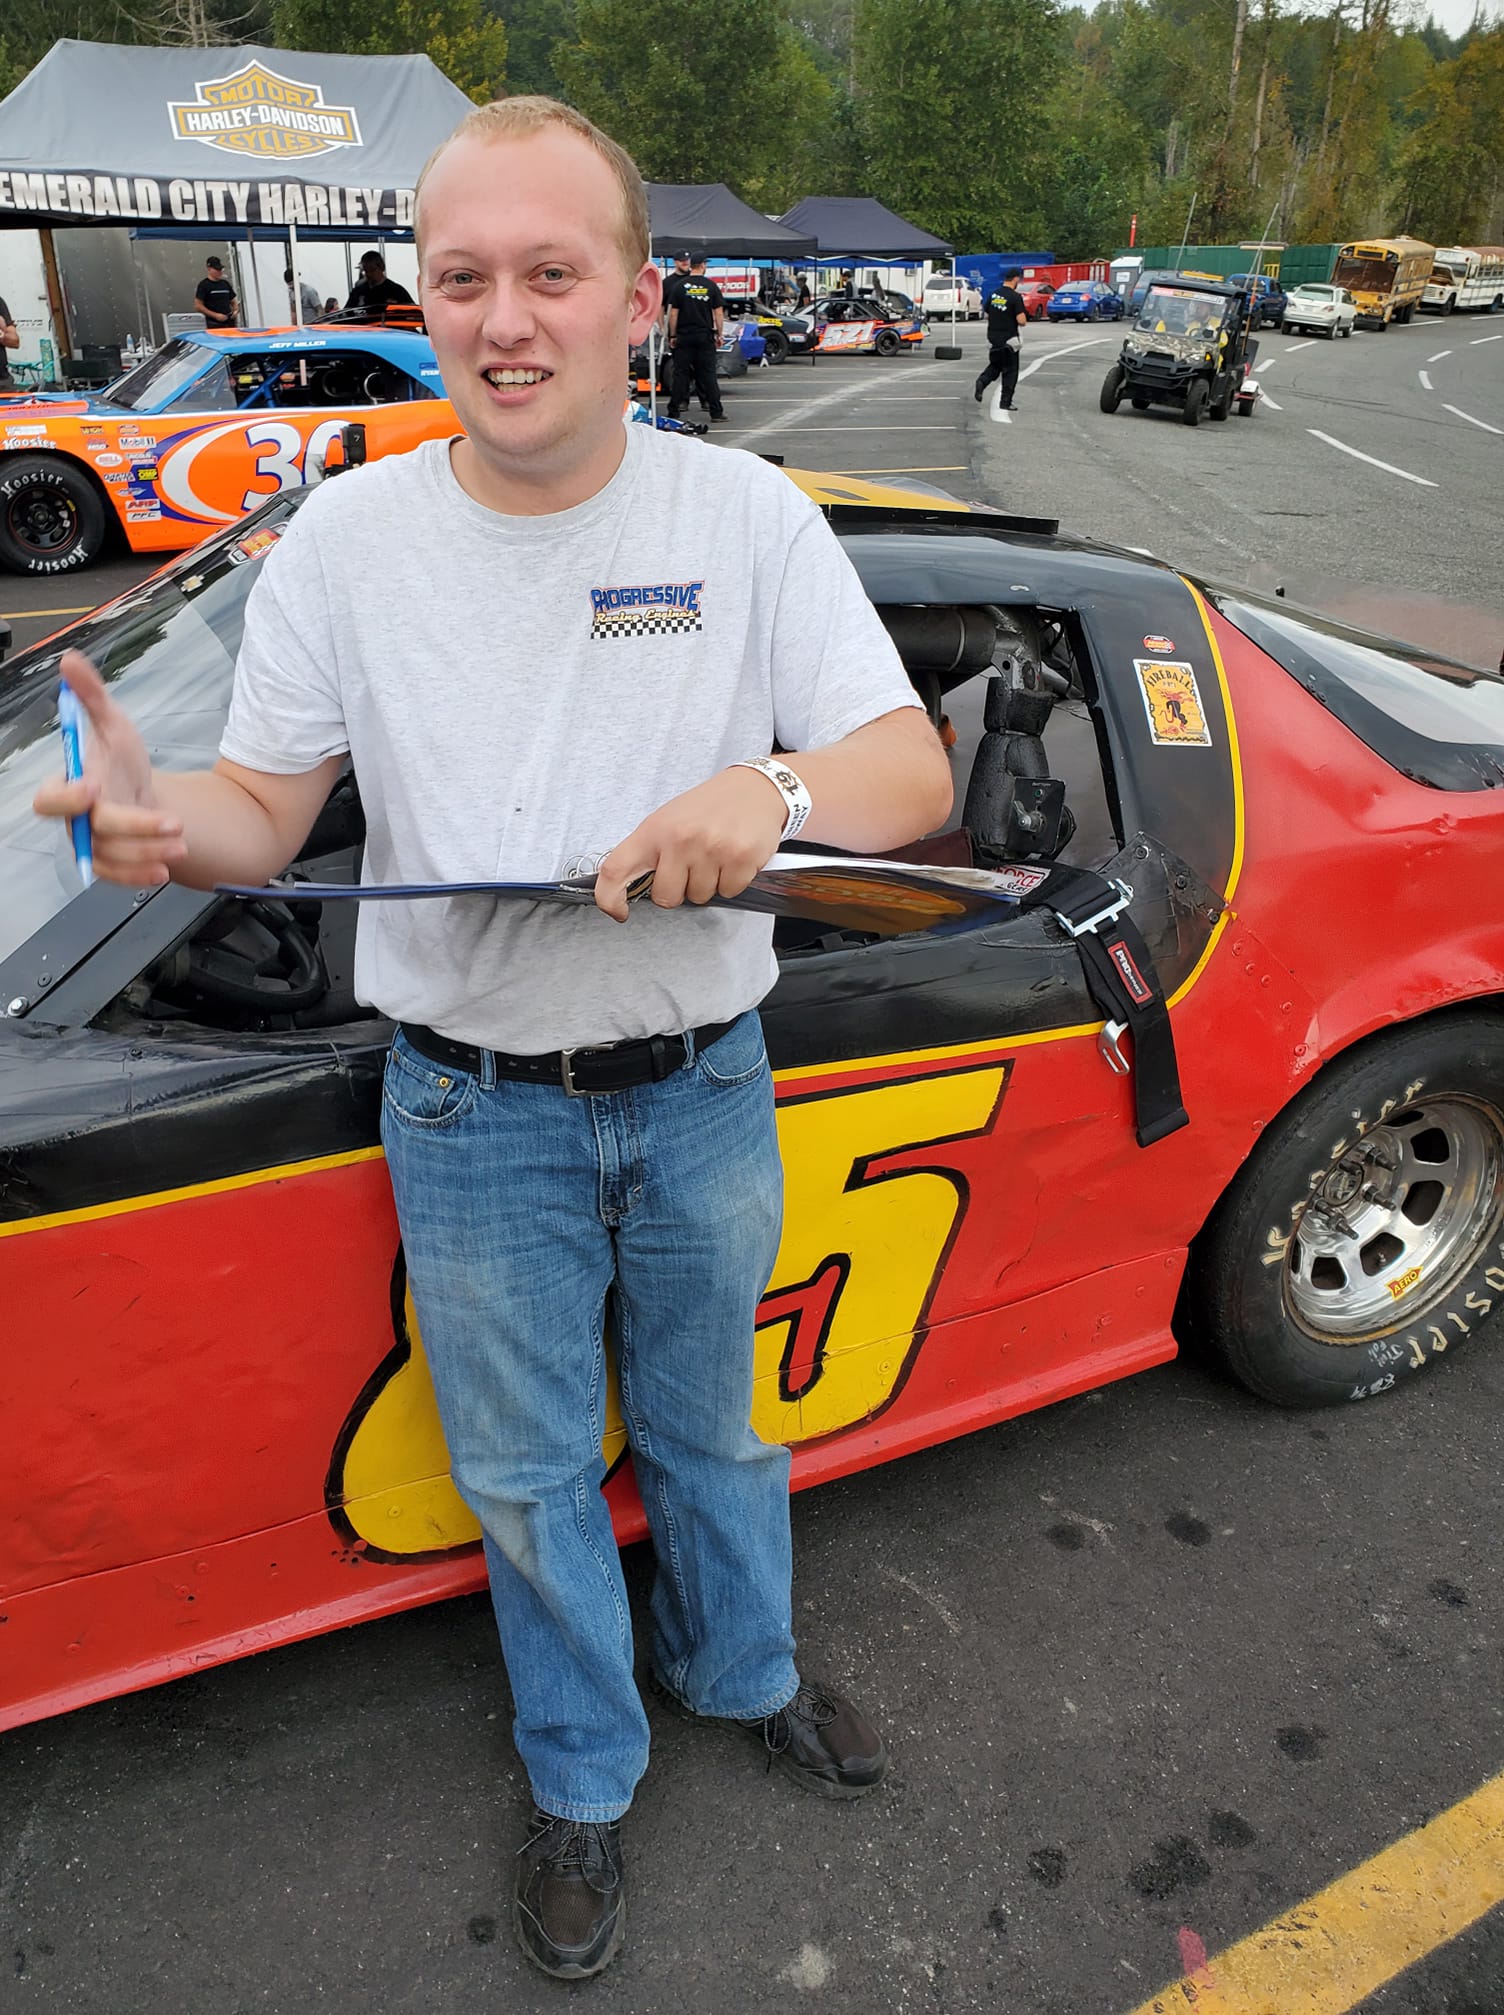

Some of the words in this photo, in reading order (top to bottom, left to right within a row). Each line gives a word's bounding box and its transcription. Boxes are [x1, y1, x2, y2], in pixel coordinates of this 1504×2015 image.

[219, 75, 303, 106] MOTOR
[186, 104, 346, 136] HARLEY-DAVIDSON
[229, 129, 313, 152] CYCLES
[0, 171, 162, 219] EMERALD
[168, 179, 251, 222] CITY
[269, 341, 292, 349] JEFF
[293, 340, 326, 348] MILLER
[822, 321, 875, 348] 521
[240, 418, 352, 512] 30
[1, 469, 63, 500] Hoosier
[28, 537, 89, 574] Hoosier
[590, 581, 703, 613] PROGRESSIVE
[595, 610, 642, 623] Racing
[644, 608, 696, 620] Engines
[1146, 669, 1191, 690] FIREBALL
[1394, 1270, 1418, 1295] AERO
